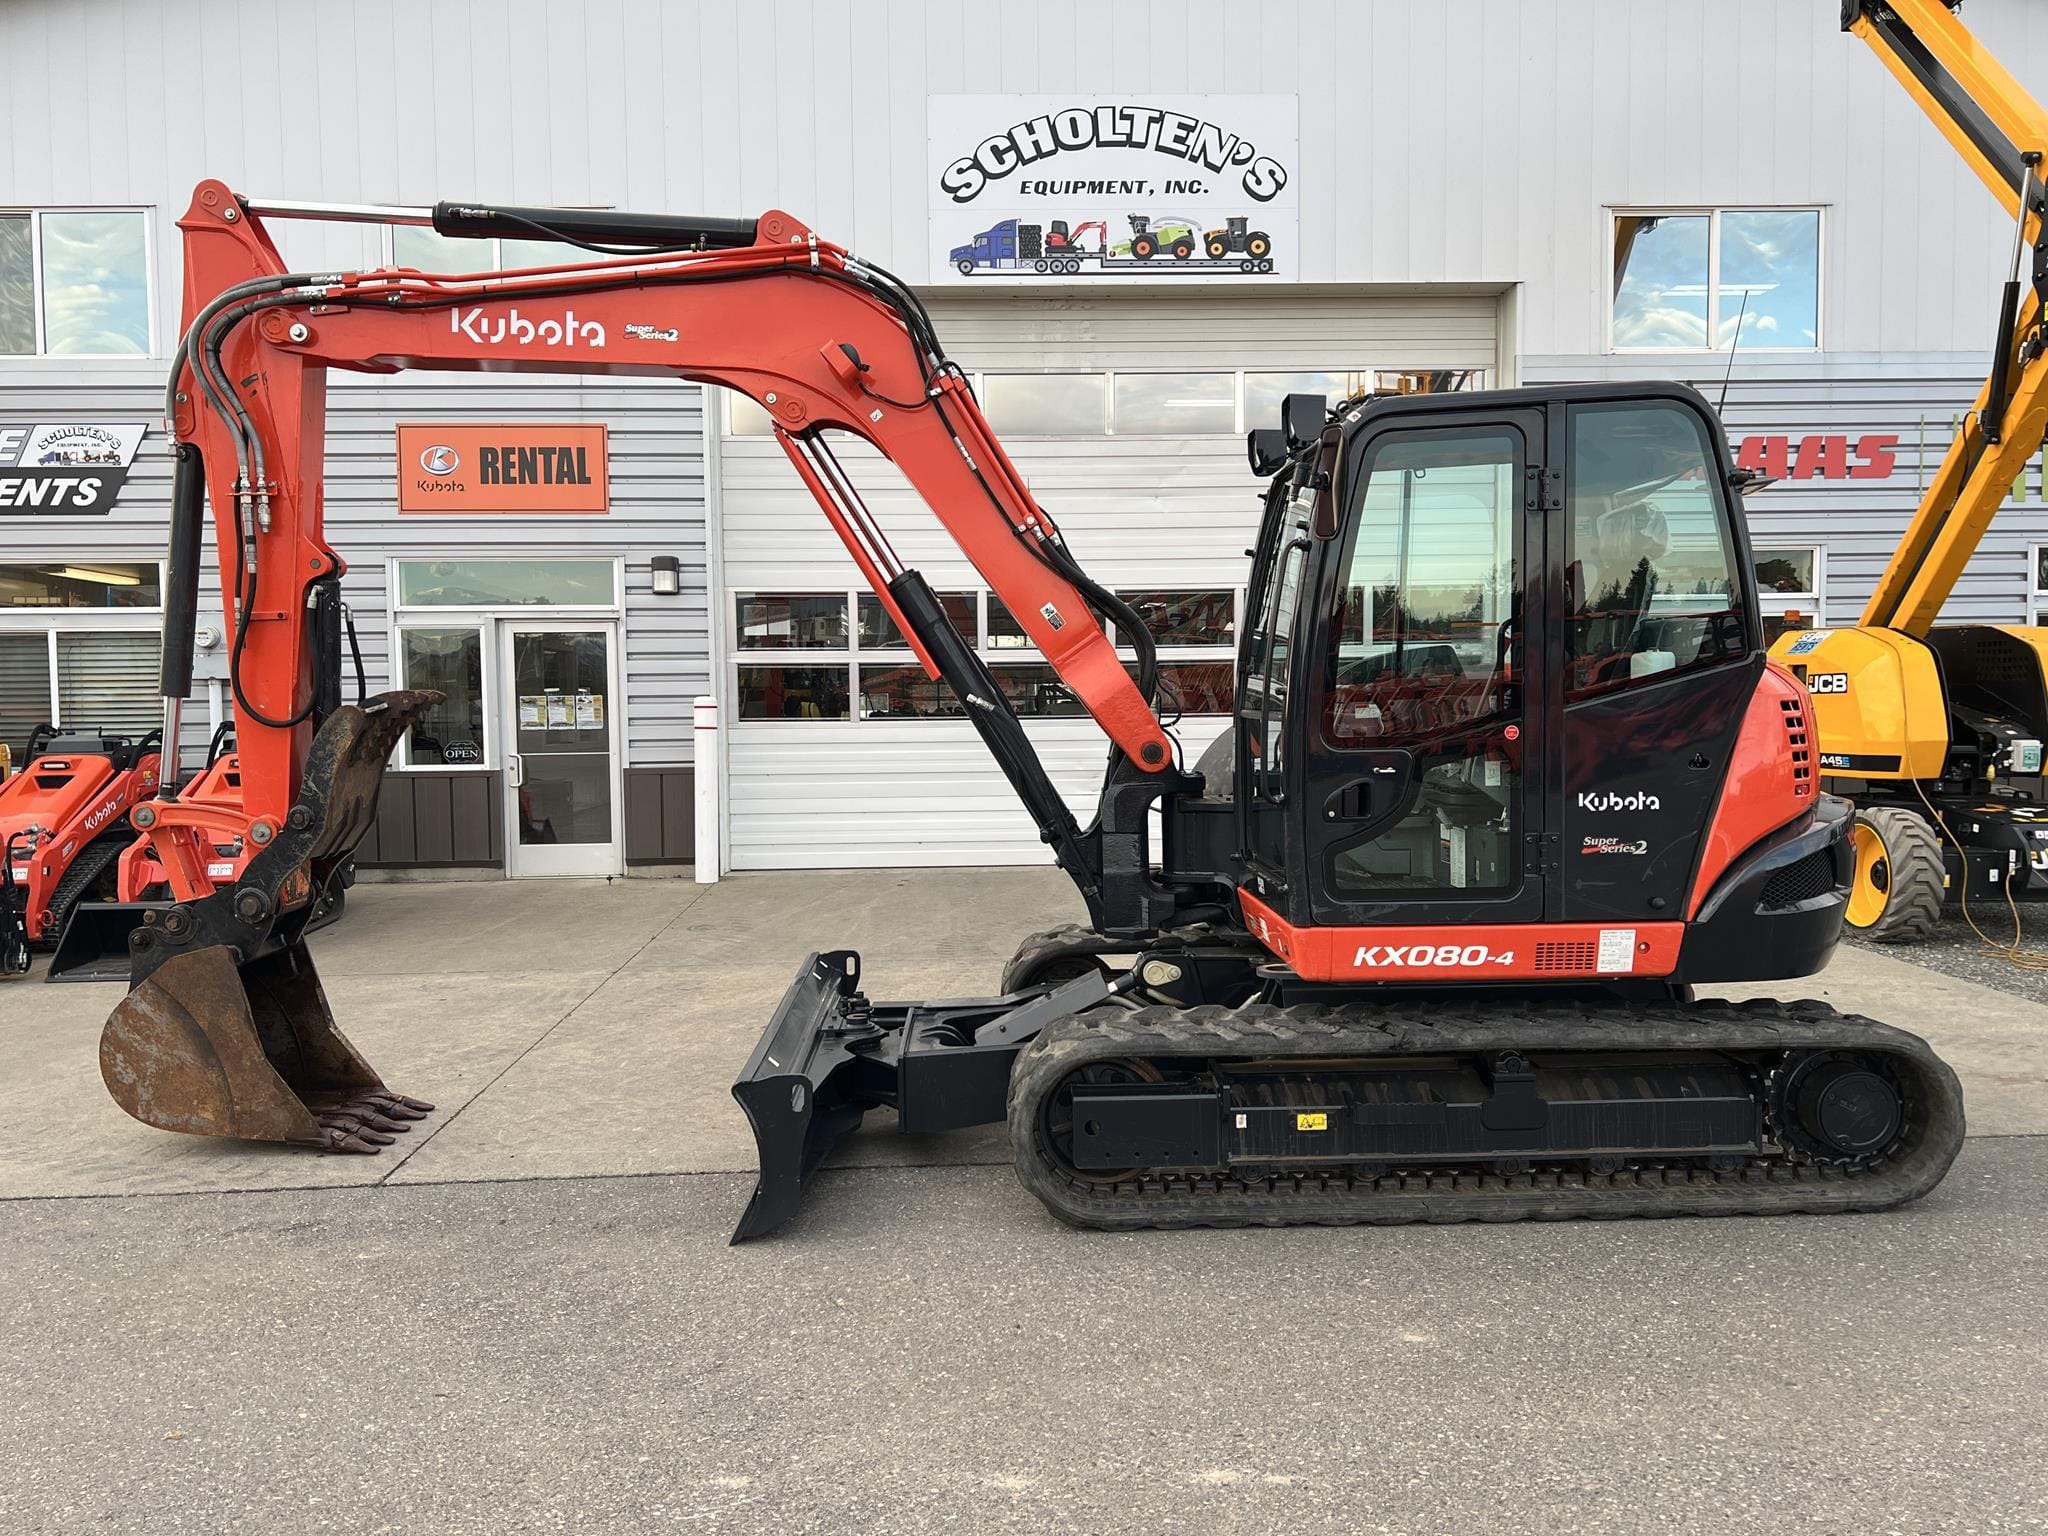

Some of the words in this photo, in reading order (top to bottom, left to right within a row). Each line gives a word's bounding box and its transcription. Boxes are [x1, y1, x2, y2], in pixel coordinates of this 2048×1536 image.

[940, 105, 1288, 204] SCHOLTEN'S
[1019, 179, 1155, 197] EQUIPMENT,
[1164, 179, 1210, 195] INC.
[451, 307, 606, 347] Kubota
[624, 323, 655, 335] Super
[38, 426, 122, 450] SCHOLTEN'S
[479, 447, 591, 485] RENTAL
[1736, 435, 1899, 480] AAS
[417, 480, 465, 492] Kubota
[1808, 674, 1847, 693] JCB
[445, 750, 478, 758] OPEN
[1820, 755, 1850, 765] A45E
[1578, 791, 1660, 811] Kubota
[84, 801, 117, 830] Kubota
[1583, 836, 1619, 848] Super
[1353, 945, 1515, 967] KX080-4
